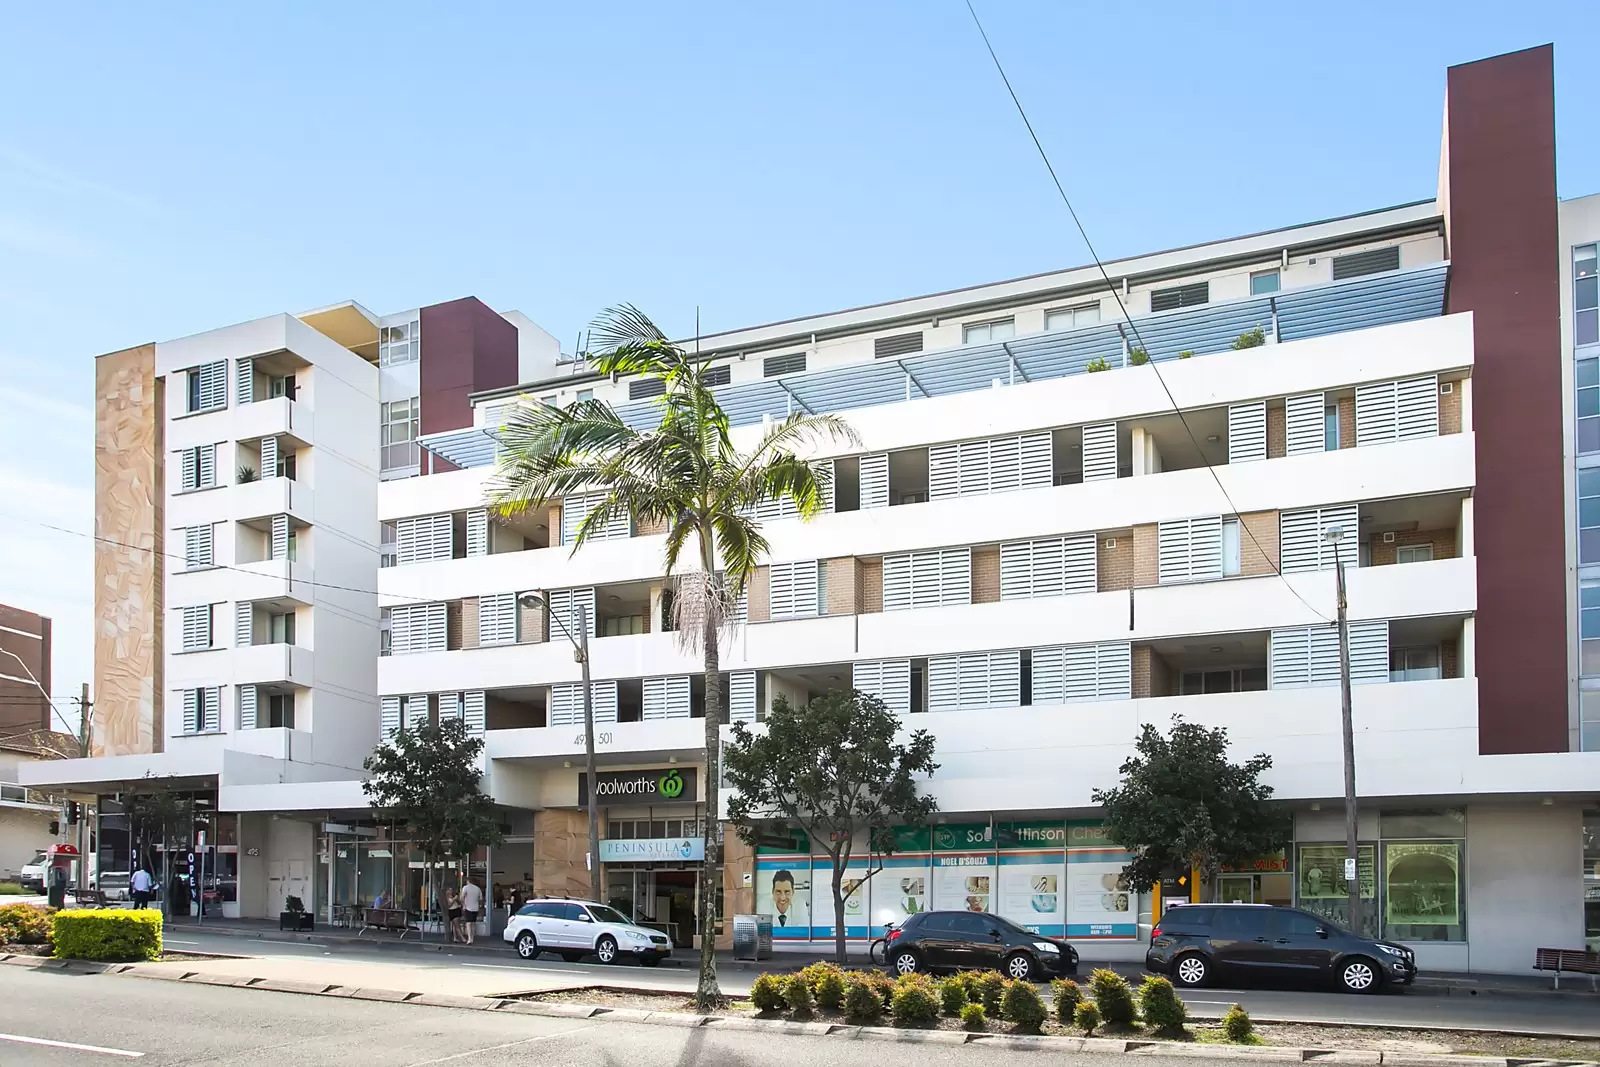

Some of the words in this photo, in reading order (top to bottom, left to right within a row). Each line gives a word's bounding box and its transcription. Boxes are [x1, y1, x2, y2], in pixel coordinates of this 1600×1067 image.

[598, 732, 613, 744] 501
[596, 777, 655, 794] oolworths
[1016, 827, 1064, 842] ttinson
[608, 843, 679, 853] PENINSULA
[940, 857, 958, 867] NOEL
[958, 856, 988, 866] D'SOUZA
[187, 852, 198, 899] OPEN
